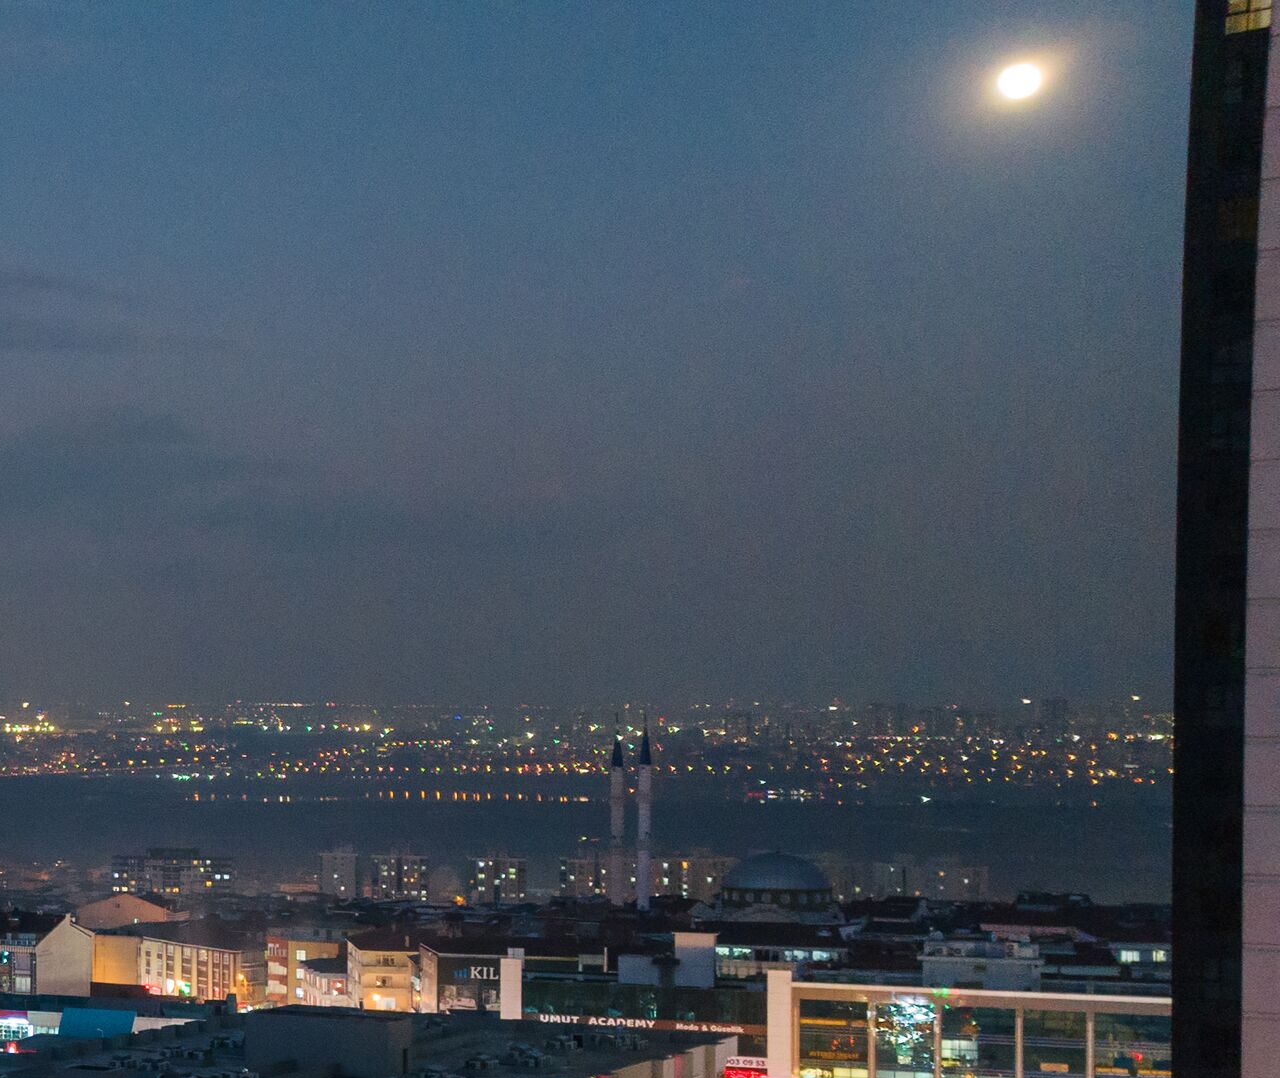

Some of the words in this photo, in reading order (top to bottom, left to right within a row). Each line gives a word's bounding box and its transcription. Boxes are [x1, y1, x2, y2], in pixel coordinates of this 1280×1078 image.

[540, 1014, 580, 1024] UMUT
[588, 1016, 656, 1029] ACADEMY
[701, 1024, 709, 1032] &
